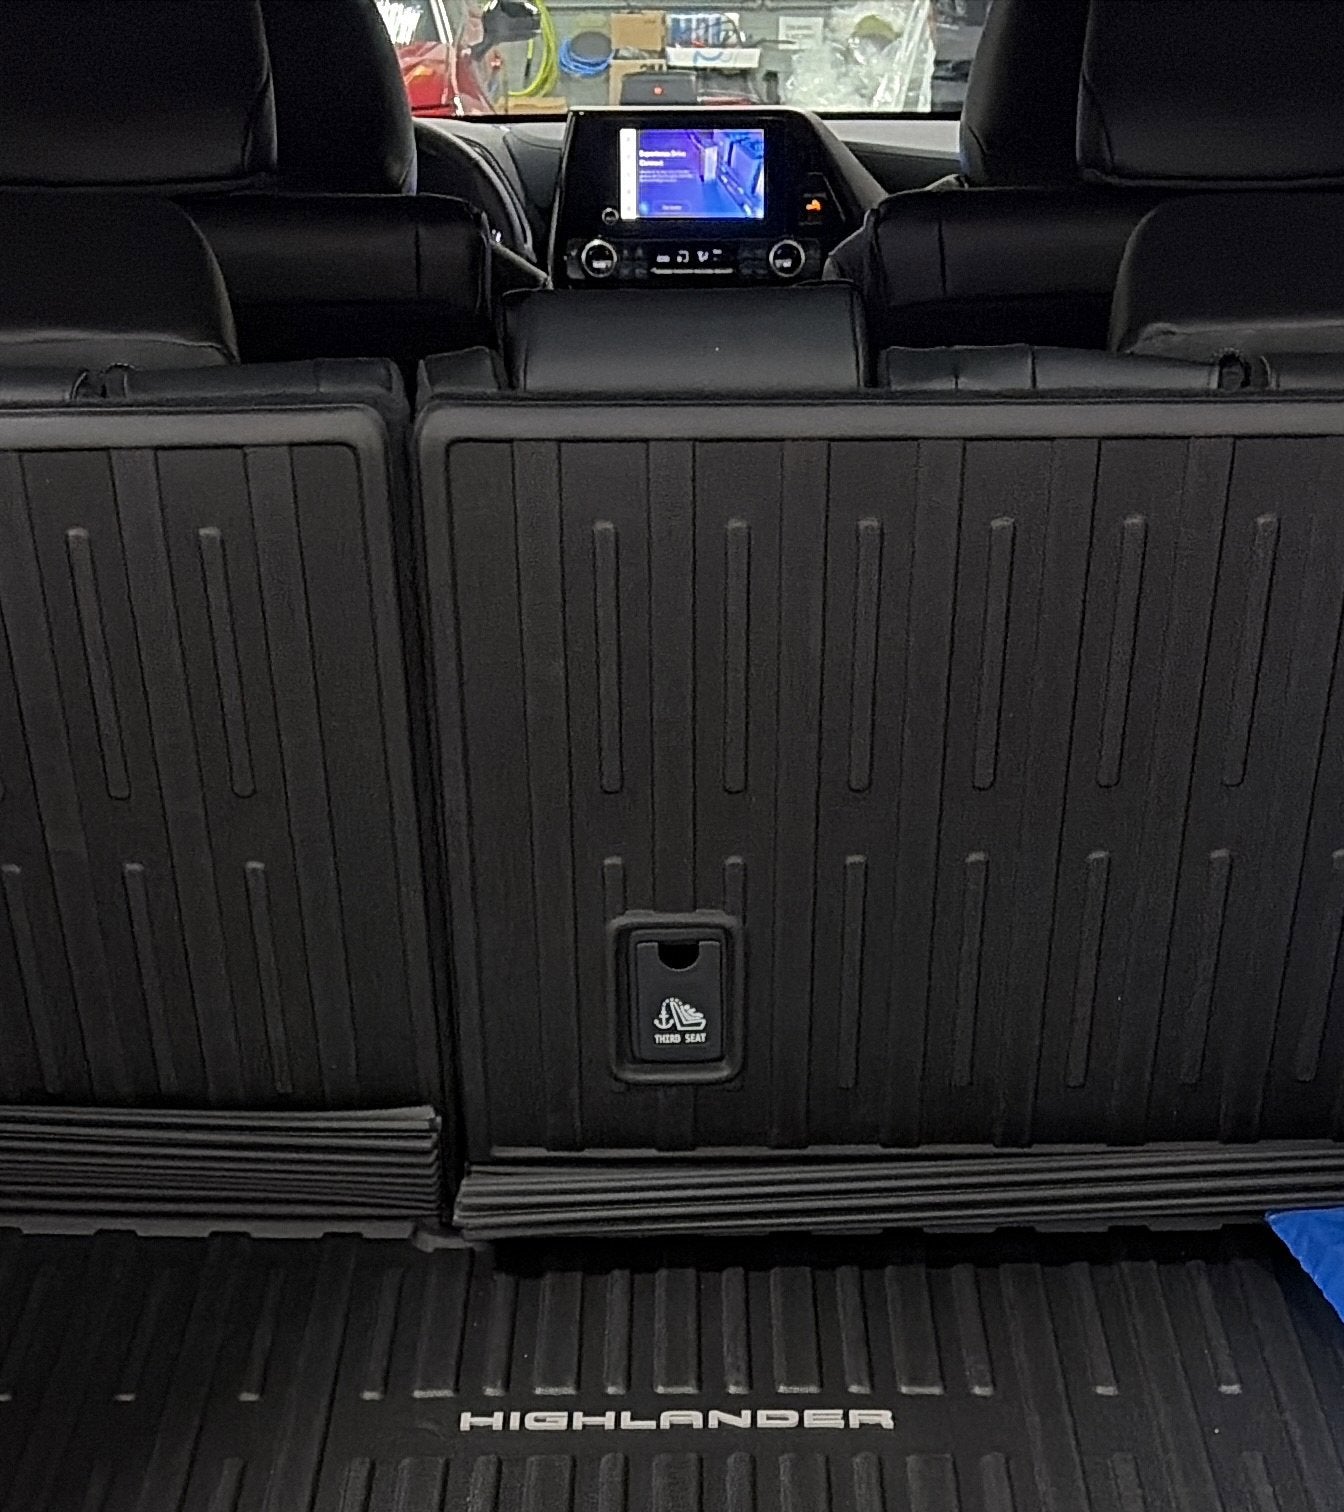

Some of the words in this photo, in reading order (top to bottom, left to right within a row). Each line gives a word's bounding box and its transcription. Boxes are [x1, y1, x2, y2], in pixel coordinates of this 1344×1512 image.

[654, 1033, 681, 1044] THIRD
[684, 1032, 707, 1043] SEAT
[459, 1408, 895, 1431] HIGHLANDER
